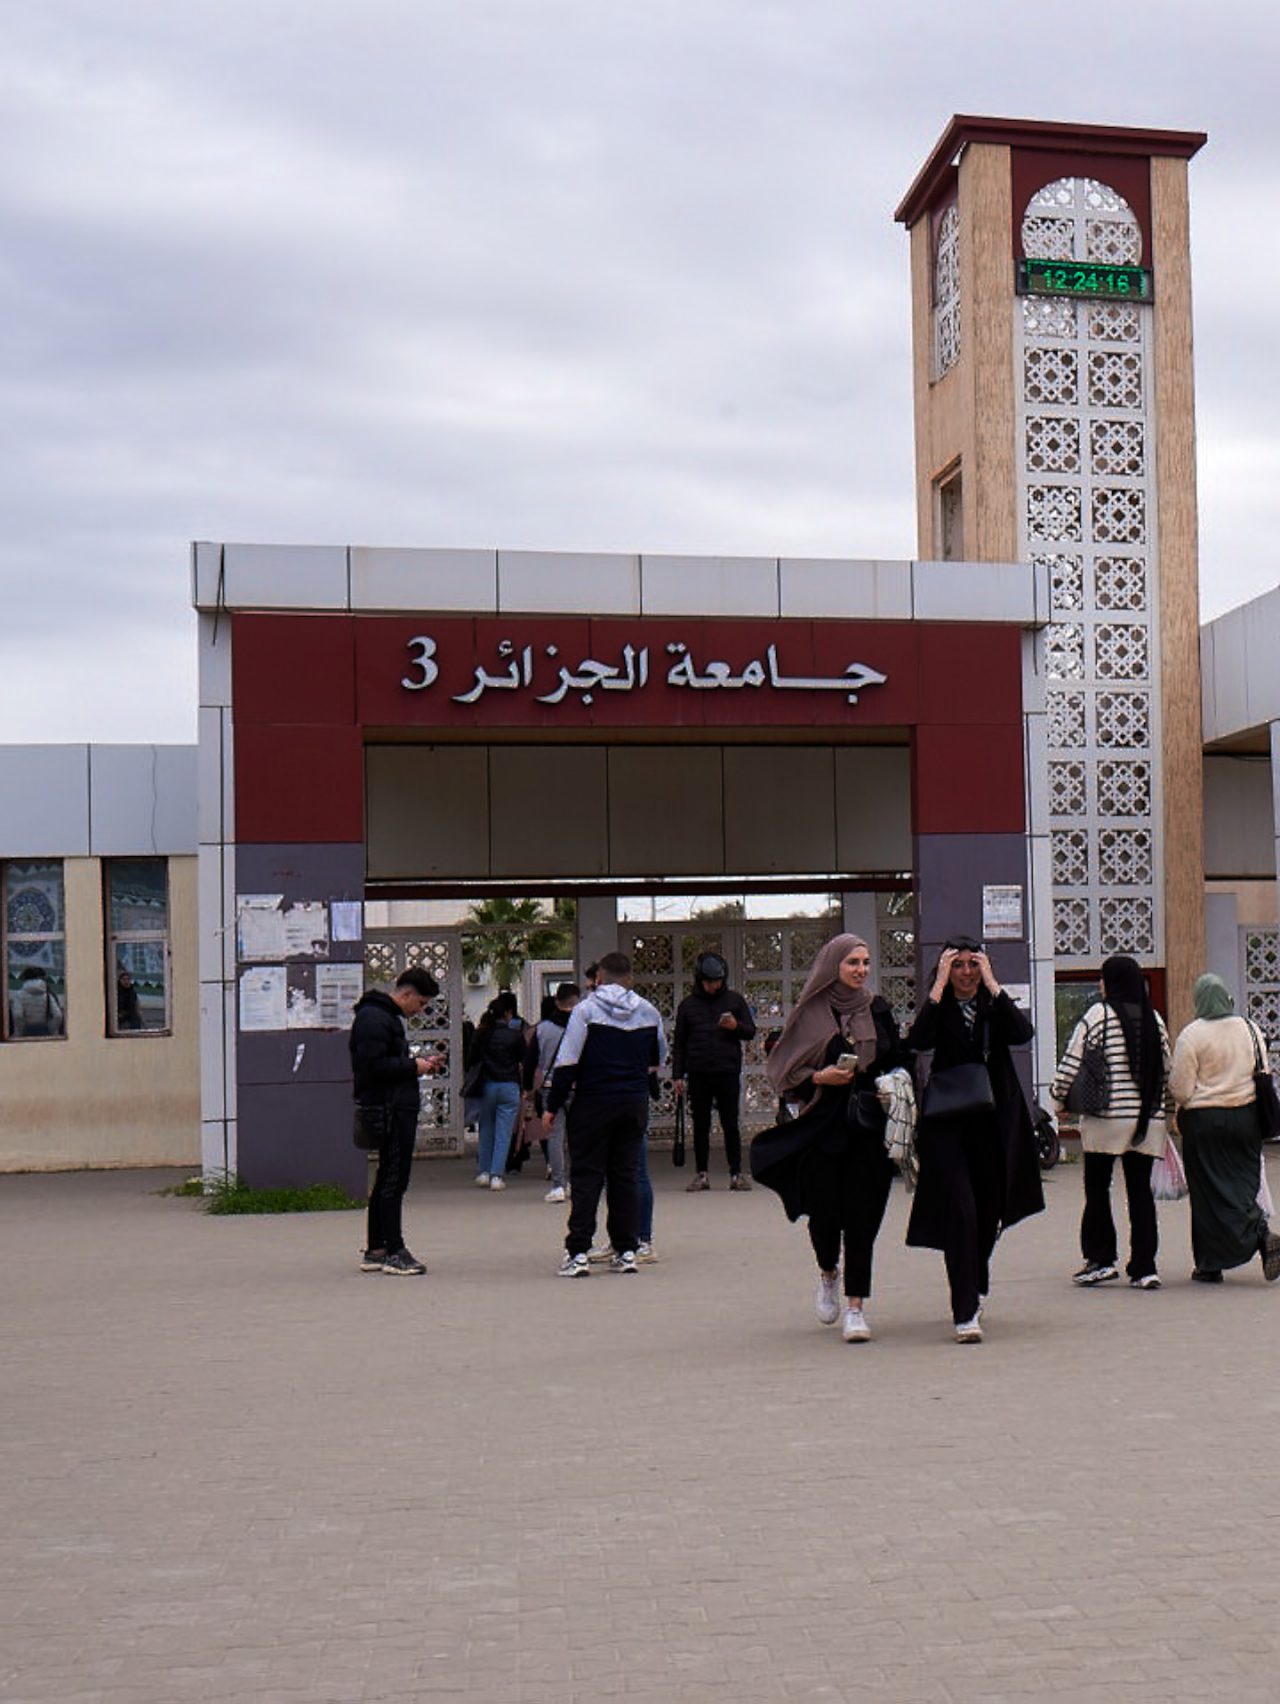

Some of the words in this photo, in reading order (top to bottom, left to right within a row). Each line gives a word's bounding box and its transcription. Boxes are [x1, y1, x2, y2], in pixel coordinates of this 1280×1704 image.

[400, 635, 439, 690] 3
[450, 639, 650, 706] الجزائر
[666, 641, 888, 704] جامعة
